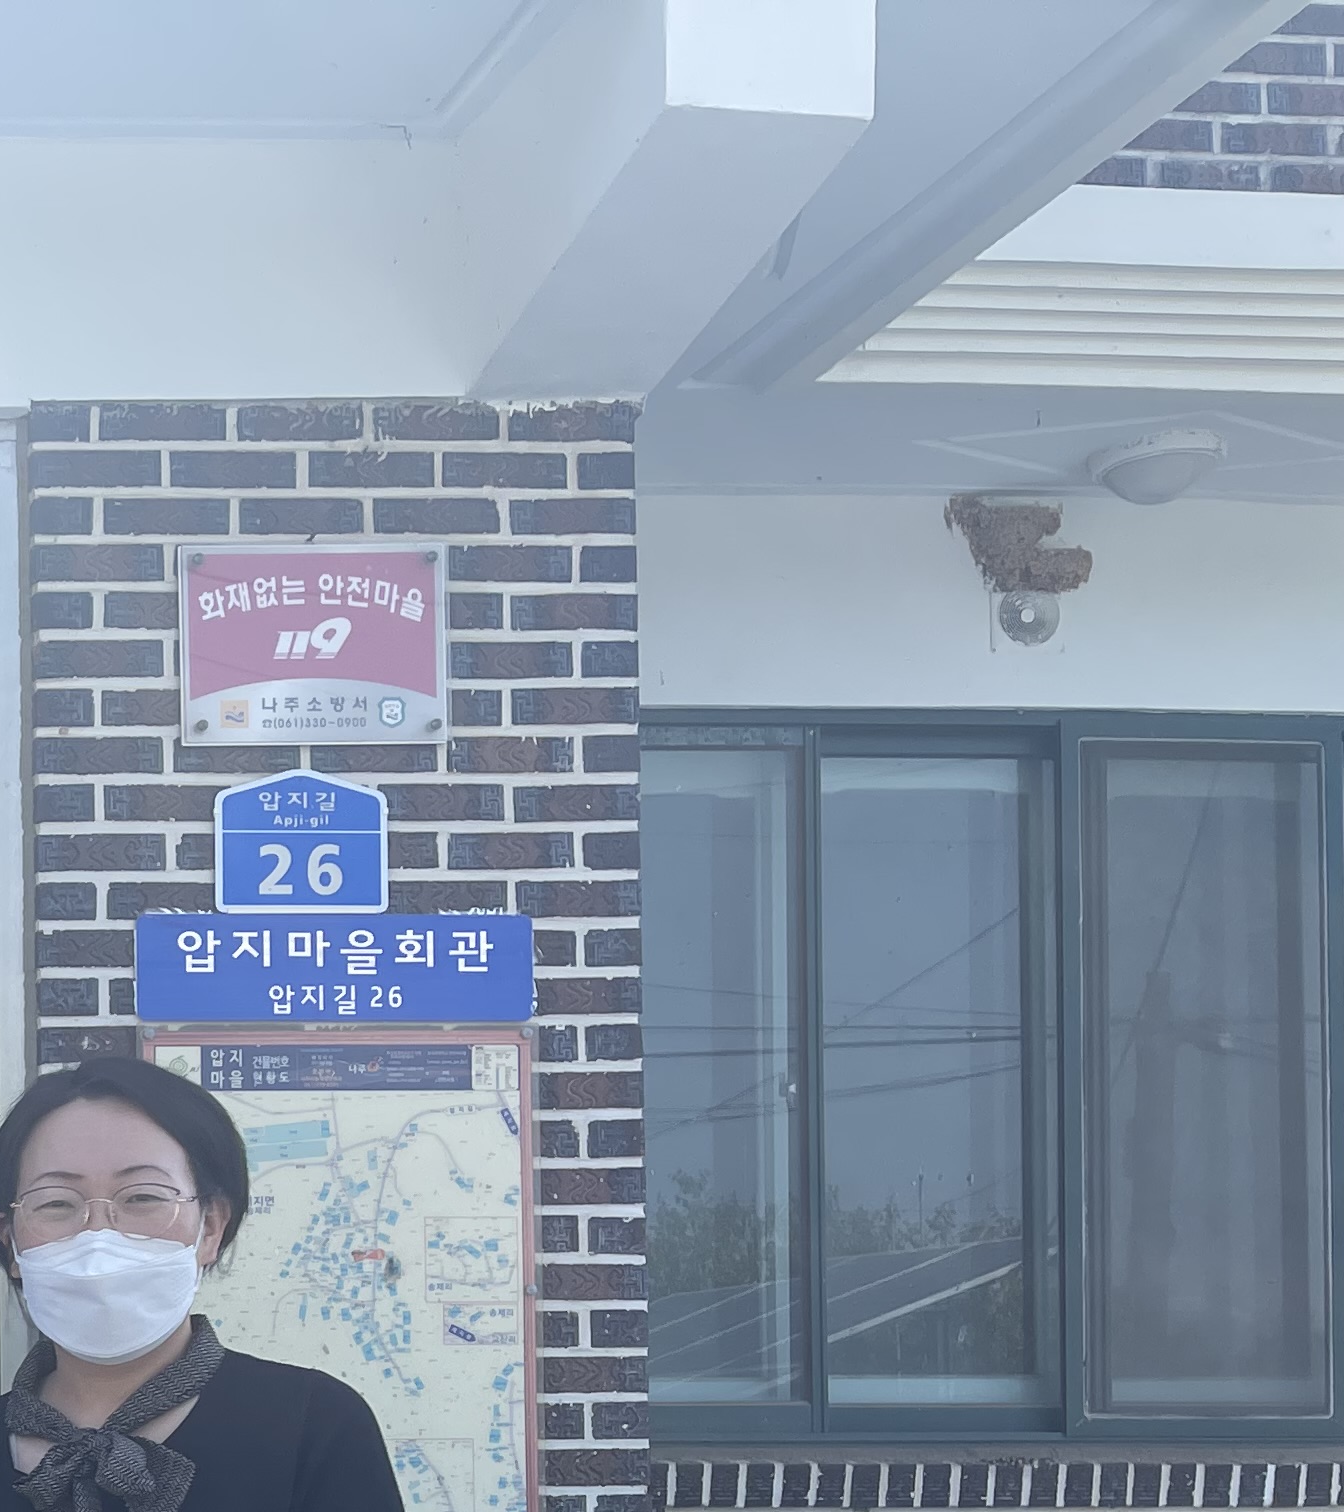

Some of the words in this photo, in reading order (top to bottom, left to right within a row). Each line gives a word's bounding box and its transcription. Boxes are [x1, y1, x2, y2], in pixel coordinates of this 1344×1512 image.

[198, 575, 306, 621] 화재없는
[317, 573, 426, 623] 안전마을
[273, 616, 353, 660] 119
[261, 696, 368, 713] 나주소방서
[258, 791, 337, 812] 압지길
[273, 814, 330, 828] Apji-gil
[258, 843, 343, 897] 26
[176, 929, 494, 976] 압지마을회관
[268, 984, 358, 1016] 압지길
[370, 985, 403, 1009] 26
[210, 1048, 243, 1067] 압지
[210, 1069, 244, 1089] 마을
